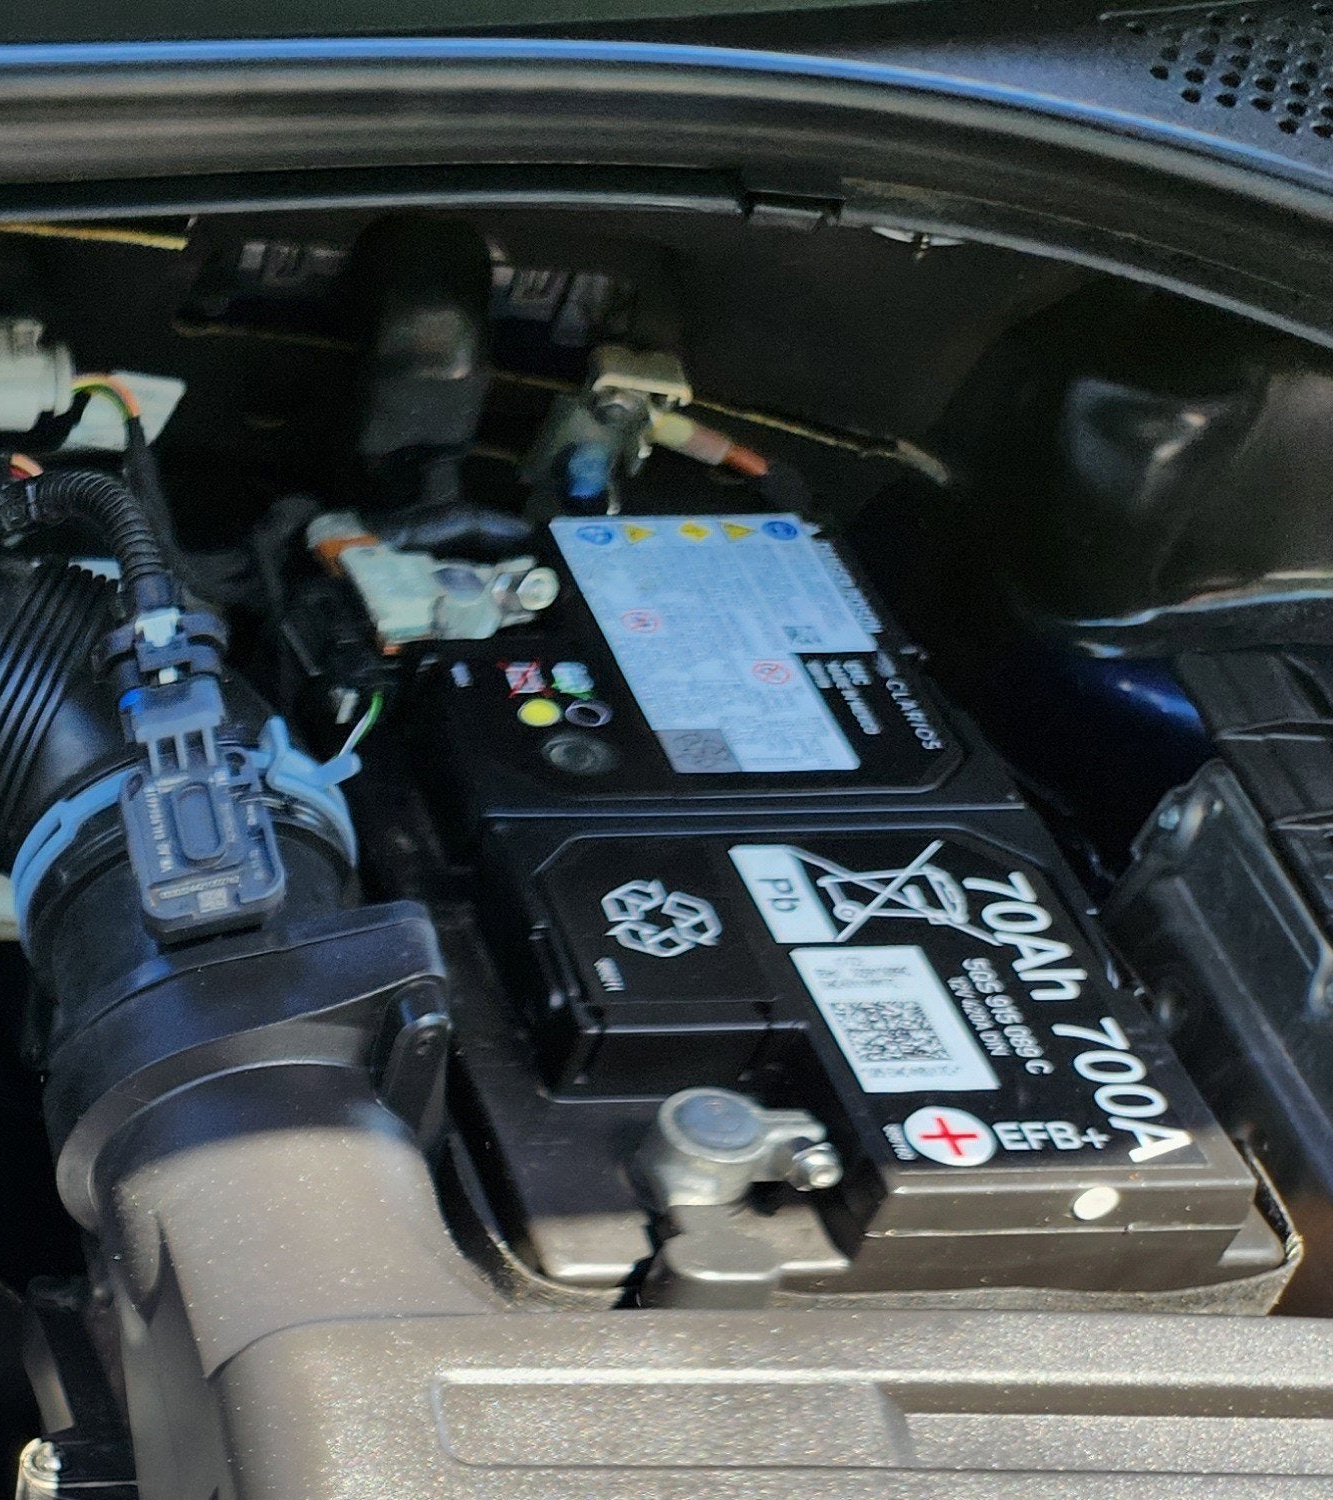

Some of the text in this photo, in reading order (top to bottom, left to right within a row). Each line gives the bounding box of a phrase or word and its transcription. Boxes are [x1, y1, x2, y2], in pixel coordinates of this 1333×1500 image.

[885, 678, 942, 749] CLARIOS
[757, 877, 801, 912] Pb
[962, 871, 1193, 1163] 70Ah 700A
[984, 994, 1025, 1025] 915
[978, 1029, 1013, 1056] DIN
[1003, 1024, 1045, 1058] 089
[991, 1120, 1112, 1151] EFB+
